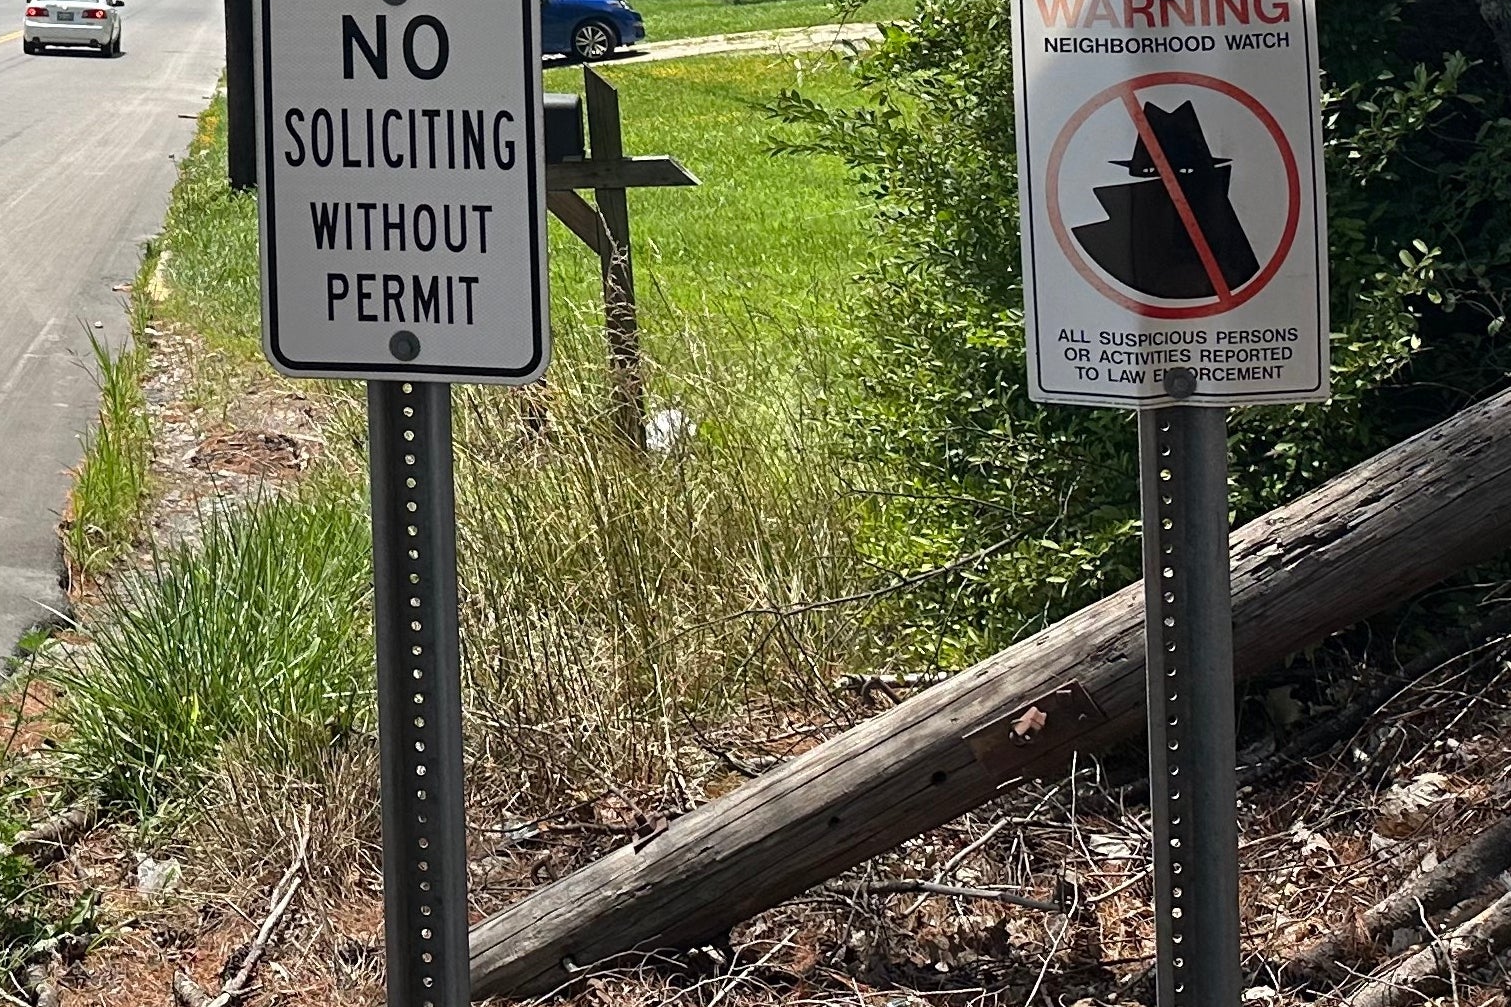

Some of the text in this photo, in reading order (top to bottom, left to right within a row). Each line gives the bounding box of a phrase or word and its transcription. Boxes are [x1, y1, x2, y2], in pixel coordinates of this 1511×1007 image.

[341, 14, 450, 81] NO
[1044, 31, 1290, 54] NEIGHBORHOOD WATCH
[284, 107, 517, 171] SOLICITING
[310, 201, 493, 254] WITHOUT
[326, 272, 480, 325] PERMIT
[1057, 327, 1299, 348] ALL SUSPICIOUS PERSONS
[1064, 346, 1293, 366] OR ACTIVITIES REPORTED
[1074, 366, 1100, 381] TO
[1108, 368, 1145, 385] LAW
